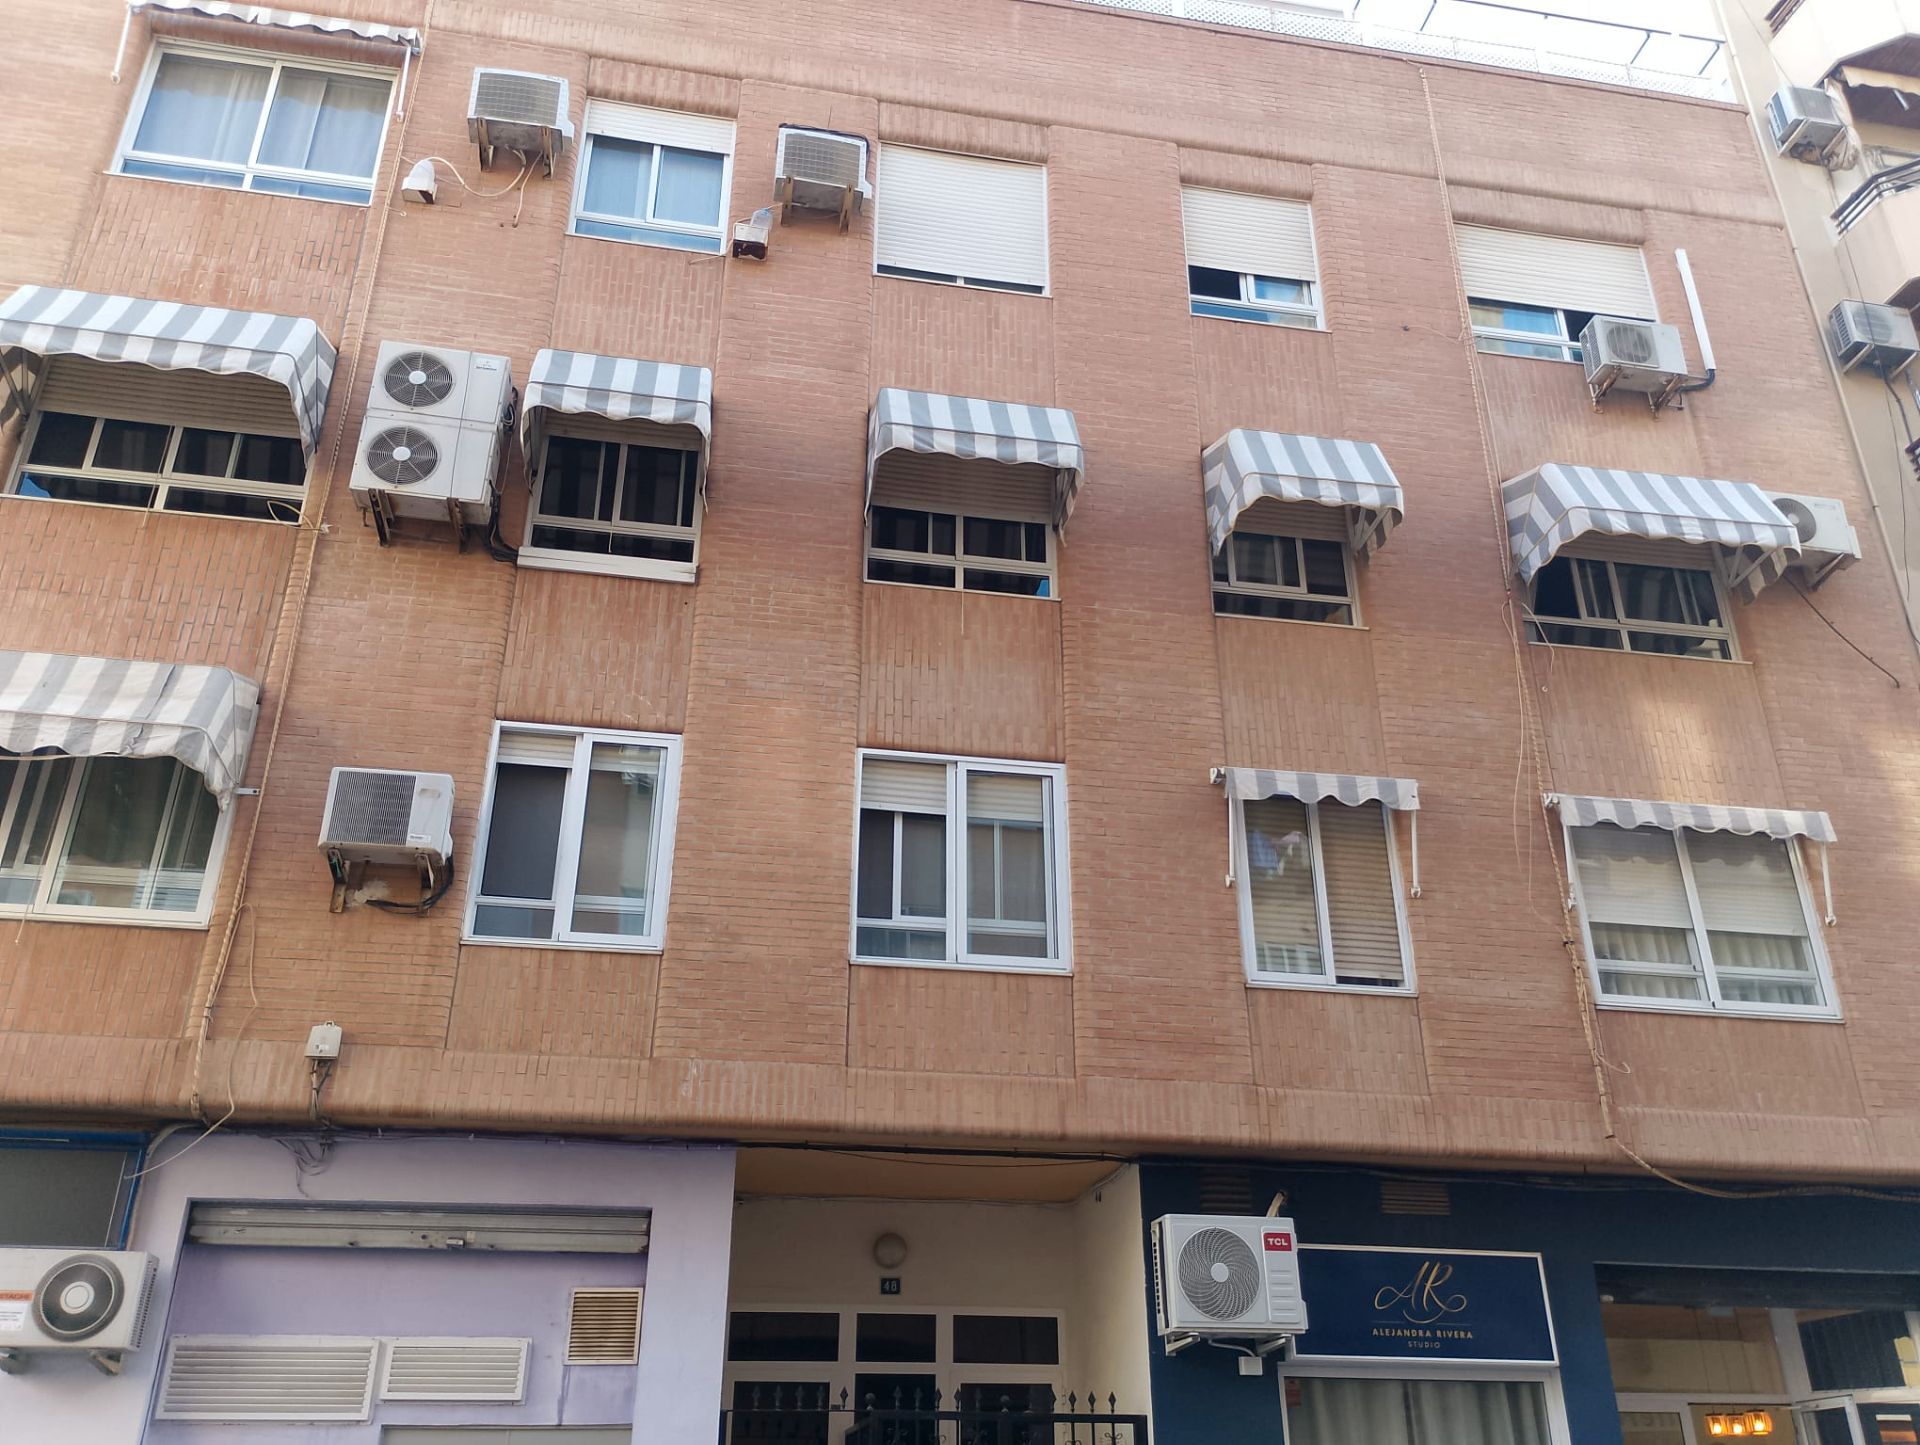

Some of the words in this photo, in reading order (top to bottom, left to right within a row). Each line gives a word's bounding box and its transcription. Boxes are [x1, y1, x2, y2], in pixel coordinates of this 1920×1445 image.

[1267, 1237, 1288, 1246] TCL
[1372, 1328, 1431, 1338] ALEJANDRA
[1436, 1329, 1473, 1339] RIVERA
[1407, 1340, 1441, 1349] STUDIO
